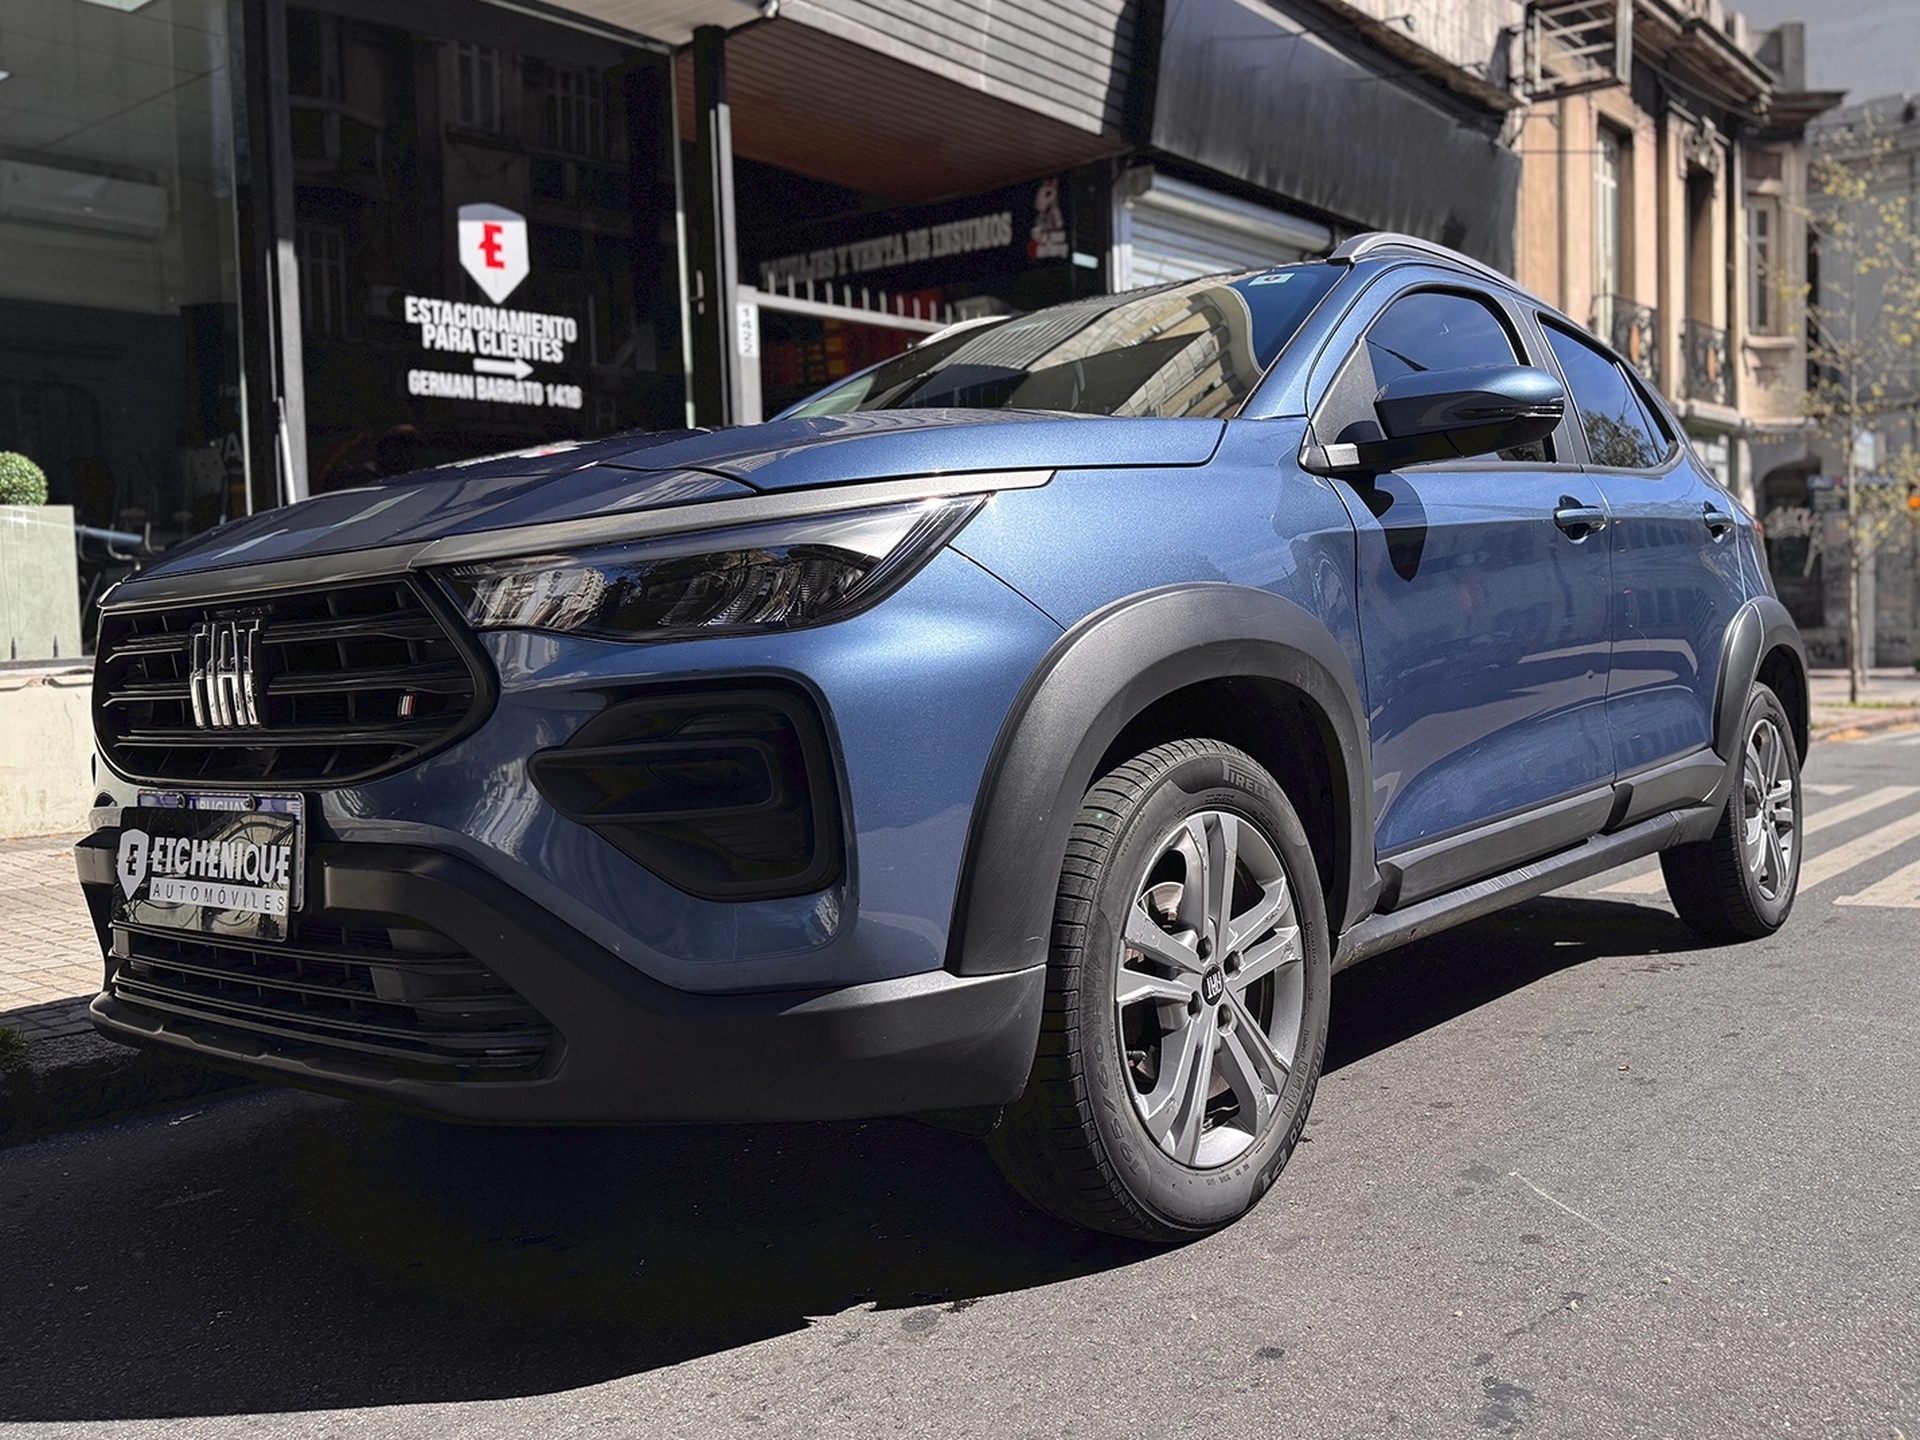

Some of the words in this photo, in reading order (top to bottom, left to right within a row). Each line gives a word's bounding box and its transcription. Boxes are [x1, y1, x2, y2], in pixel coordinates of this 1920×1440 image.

[850, 233, 904, 271] VENTA
[906, 227, 930, 262] DE
[931, 213, 1012, 258] INSUMOS
[404, 295, 577, 343] ESTACIONAMIENTO
[422, 323, 476, 354] PARA
[477, 329, 565, 363] CLIENTES
[408, 369, 474, 399] GERMAN
[475, 375, 544, 405] BARBATO
[150, 836, 291, 885] ETCHENIQUE
[152, 885, 286, 913] AUTOMÓVILES
